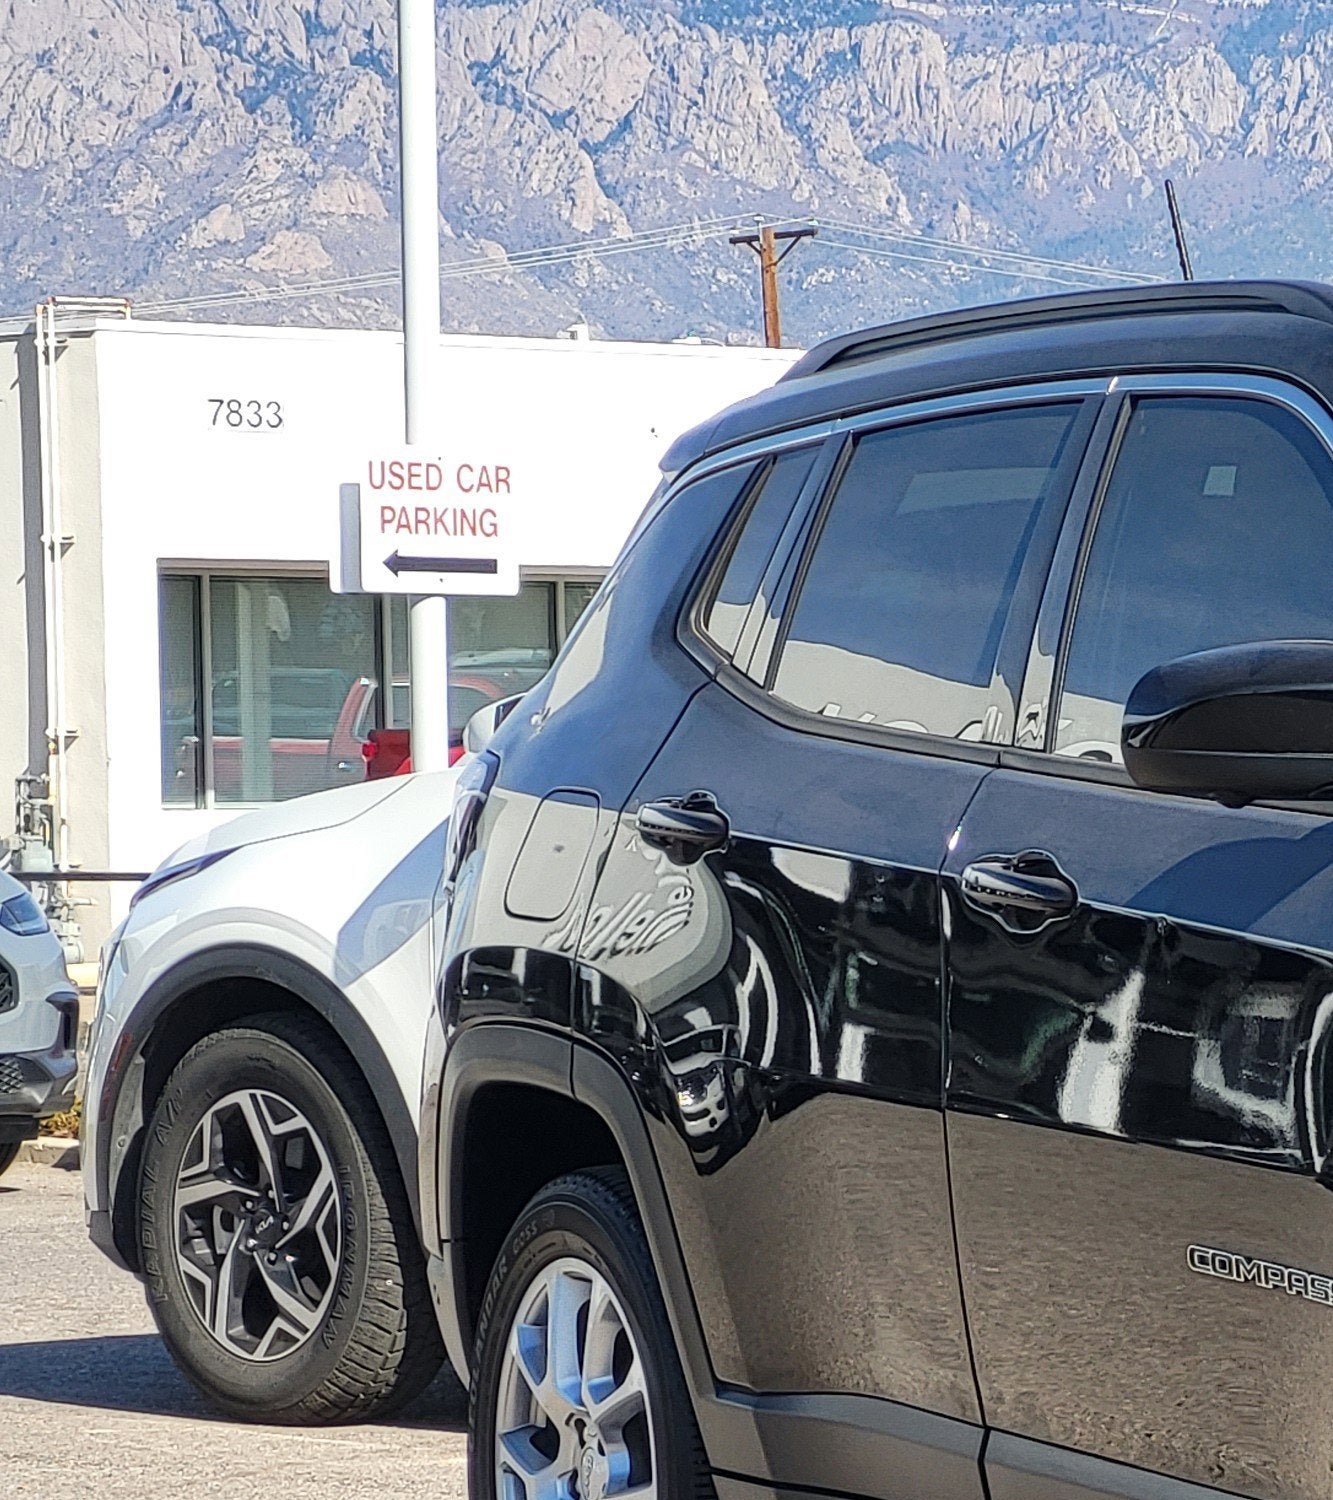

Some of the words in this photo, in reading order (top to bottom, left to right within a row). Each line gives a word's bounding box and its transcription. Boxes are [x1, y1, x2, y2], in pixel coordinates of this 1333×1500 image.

[207, 398, 284, 429] 7833
[368, 460, 443, 491] USED
[456, 463, 511, 494] CAR
[380, 505, 499, 538] PARKING
